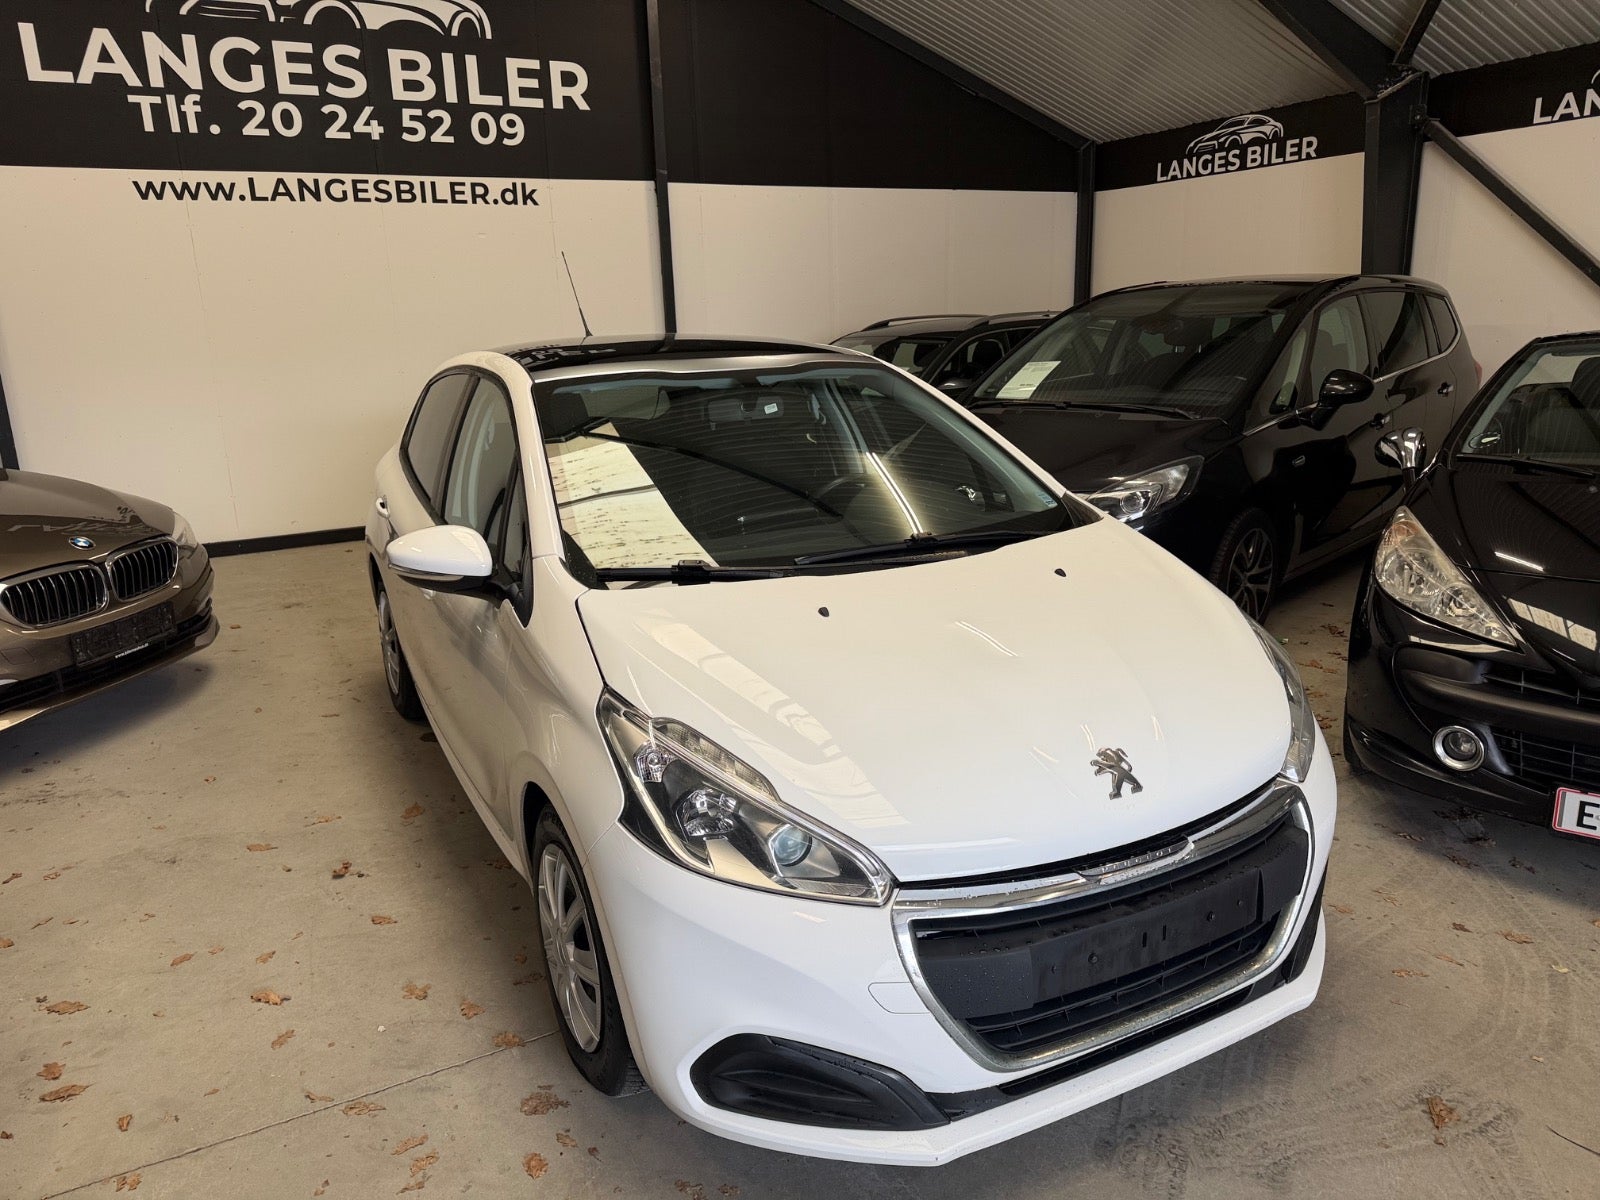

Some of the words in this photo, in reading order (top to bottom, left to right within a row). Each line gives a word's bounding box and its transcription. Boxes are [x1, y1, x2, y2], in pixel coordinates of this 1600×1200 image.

[17, 22, 368, 99] LANGES
[387, 48, 591, 111] BILER
[127, 94, 221, 135] Tlf.
[237, 100, 303, 138] 20
[320, 104, 384, 141] 24
[401, 108, 455, 143] 52
[470, 111, 525, 146] 09
[1156, 149, 1240, 182] LANGES
[1246, 136, 1318, 168] BILER
[132, 177, 540, 206] www.LANGESBILER.dk
